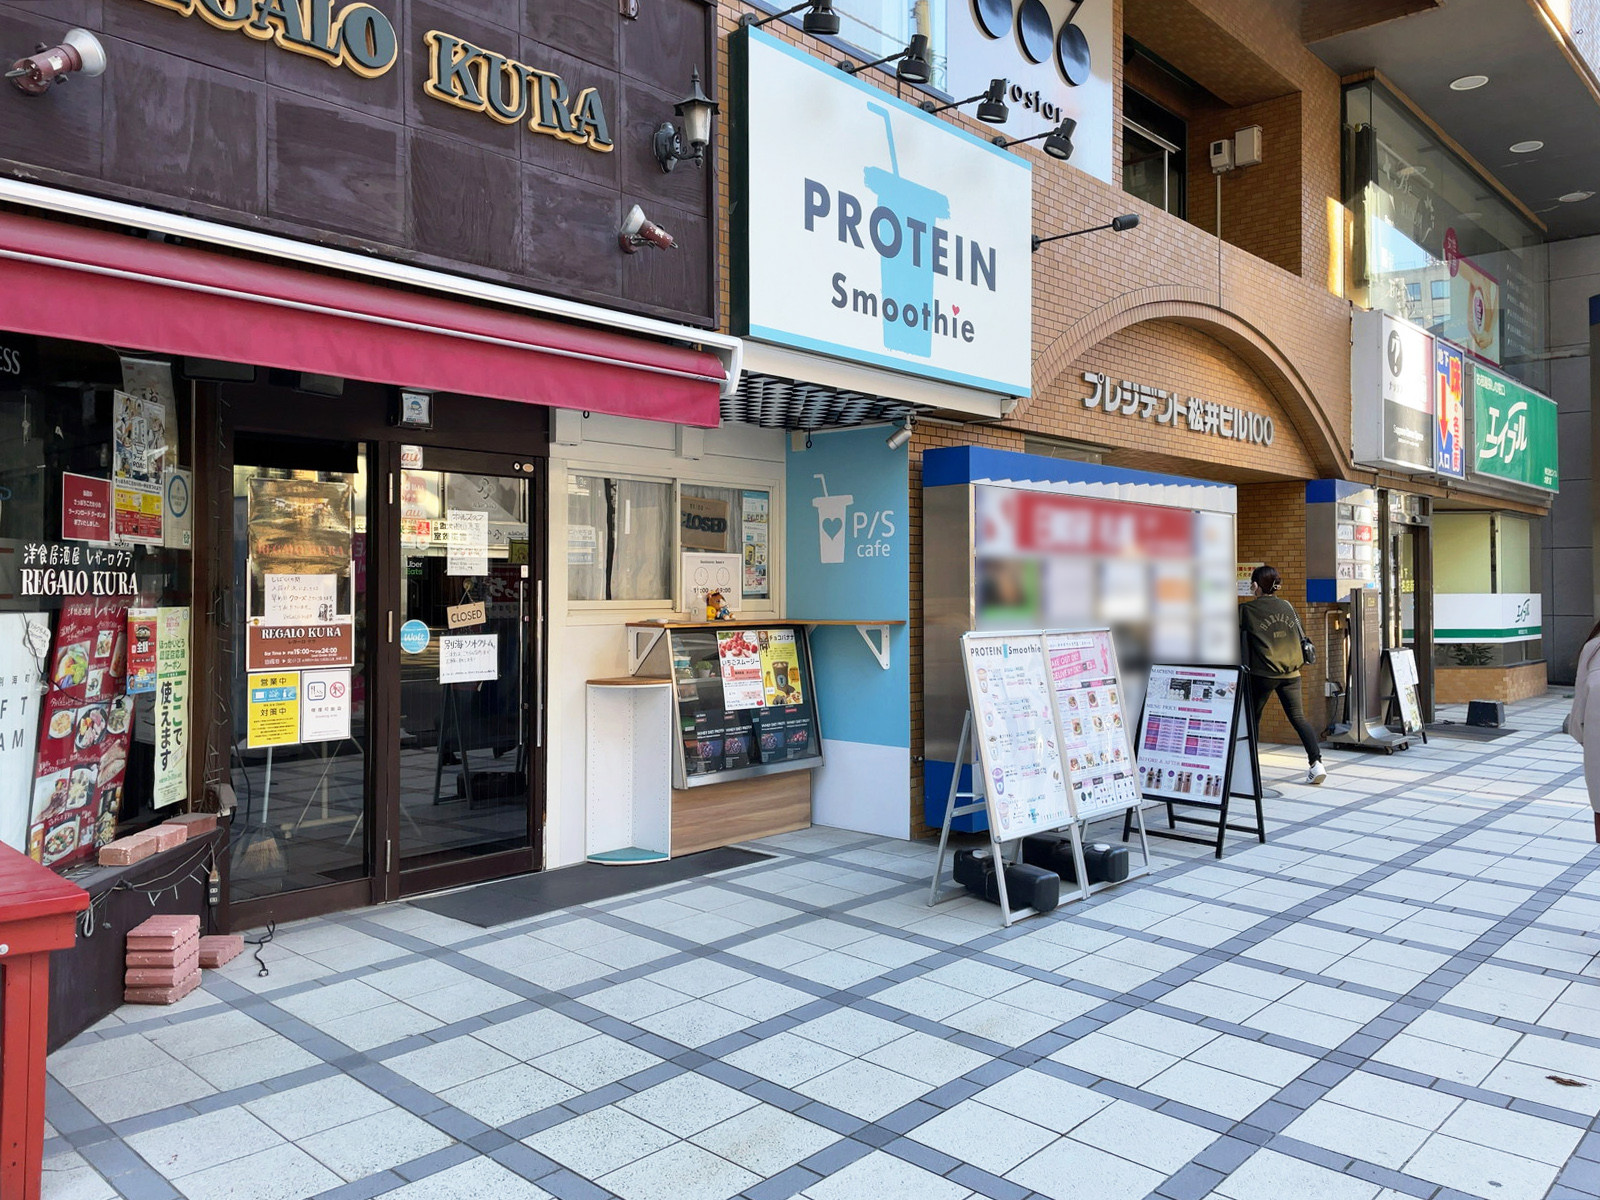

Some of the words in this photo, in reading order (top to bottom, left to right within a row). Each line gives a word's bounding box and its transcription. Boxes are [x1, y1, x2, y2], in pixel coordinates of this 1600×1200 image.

[423, 30, 614, 152] KURA
[804, 177, 997, 292] PROTEIN
[831, 272, 975, 343] Smoothie
[0, 346, 20, 375] SS
[1083, 371, 1275, 447] プレジデント松井ビル100
[1480, 401, 1528, 464] エイブル
[853, 510, 896, 540] P/S
[24, 543, 80, 566] 洋食居酒屋
[86, 548, 134, 568] レガーロクラ
[856, 539, 891, 558] cafe
[20, 568, 89, 596] REGALO
[92, 570, 139, 596] KURA
[451, 609, 483, 623] CLOSED
[262, 628, 305, 639] REGALO
[308, 627, 341, 637] KURA
[403, 634, 425, 642] Wolt
[970, 646, 1003, 656] PROTEIN
[1008, 644, 1041, 655] Smoothie
[260, 677, 287, 686] 営業中
[160, 680, 171, 771] 使えます
[172, 680, 182, 746] ここで
[260, 707, 287, 717] 対策中
